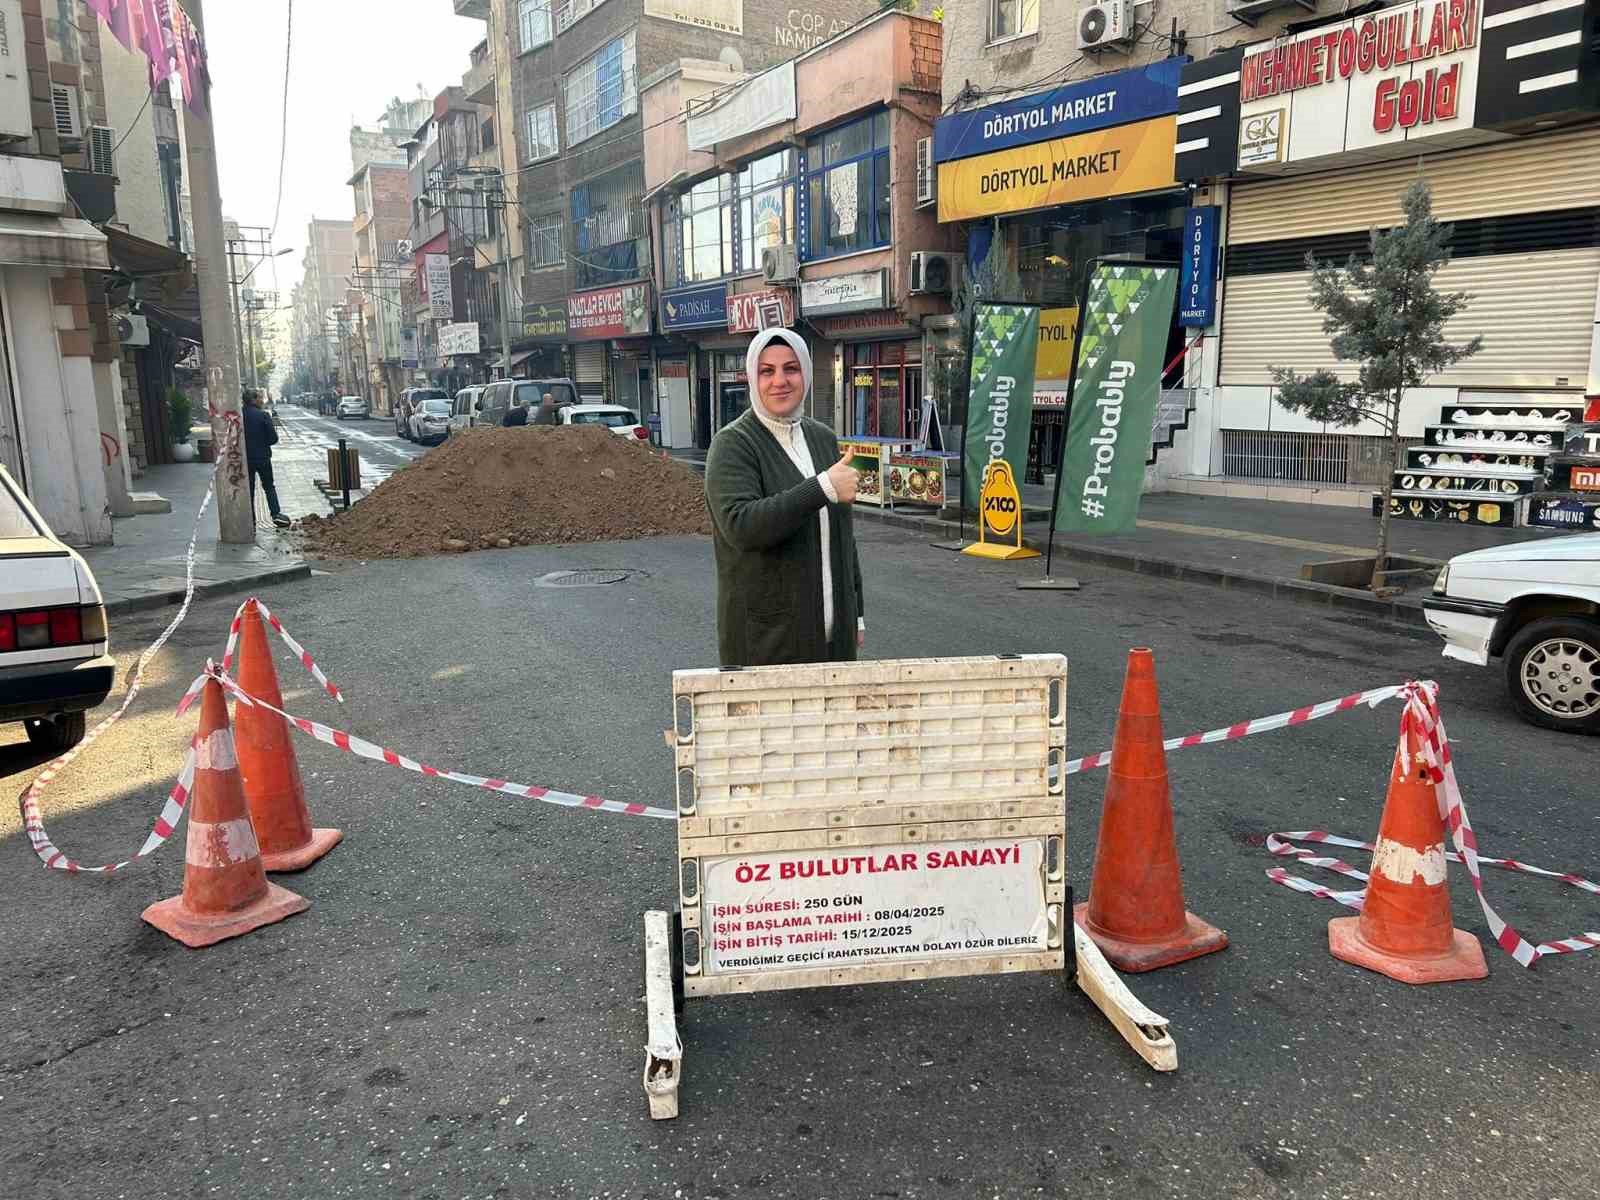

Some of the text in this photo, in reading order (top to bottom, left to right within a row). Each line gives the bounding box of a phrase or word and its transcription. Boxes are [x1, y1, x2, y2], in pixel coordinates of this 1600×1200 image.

[1373, 62, 1462, 133] Gold
[983, 91, 1117, 139] DÖRTYOL MARKET
[981, 150, 1121, 194] DÖRTYOL MARKET
[1191, 215, 1202, 308] DÖRTYOL
[1181, 310, 1206, 319] MARKET
[1039, 326, 1067, 341] TYOL
[1034, 395, 1052, 405] TYOL
[1081, 360, 1135, 519] #Probably
[985, 496, 1016, 513] %100
[1539, 508, 1584, 523] SAMSUNG
[735, 843, 1020, 883] ÖZ BULUTLAR SANAYİ
[713, 904, 741, 918] İŞİN
[804, 898, 828, 909] 250
[833, 894, 863, 906] GÜN
[713, 921, 741, 935] İŞİN
[746, 916, 812, 932] BAŞLAMA
[874, 906, 945, 921] 08/04/2025
[713, 937, 742, 951] İŞİN
[746, 933, 783, 948] BİTİŞ
[842, 925, 912, 940] 15/12/2025
[719, 955, 784, 968] VERDİĞİMİZ
[827, 944, 920, 960] RAHATSIZLIKTAN
[923, 941, 962, 952] DOLAYI
